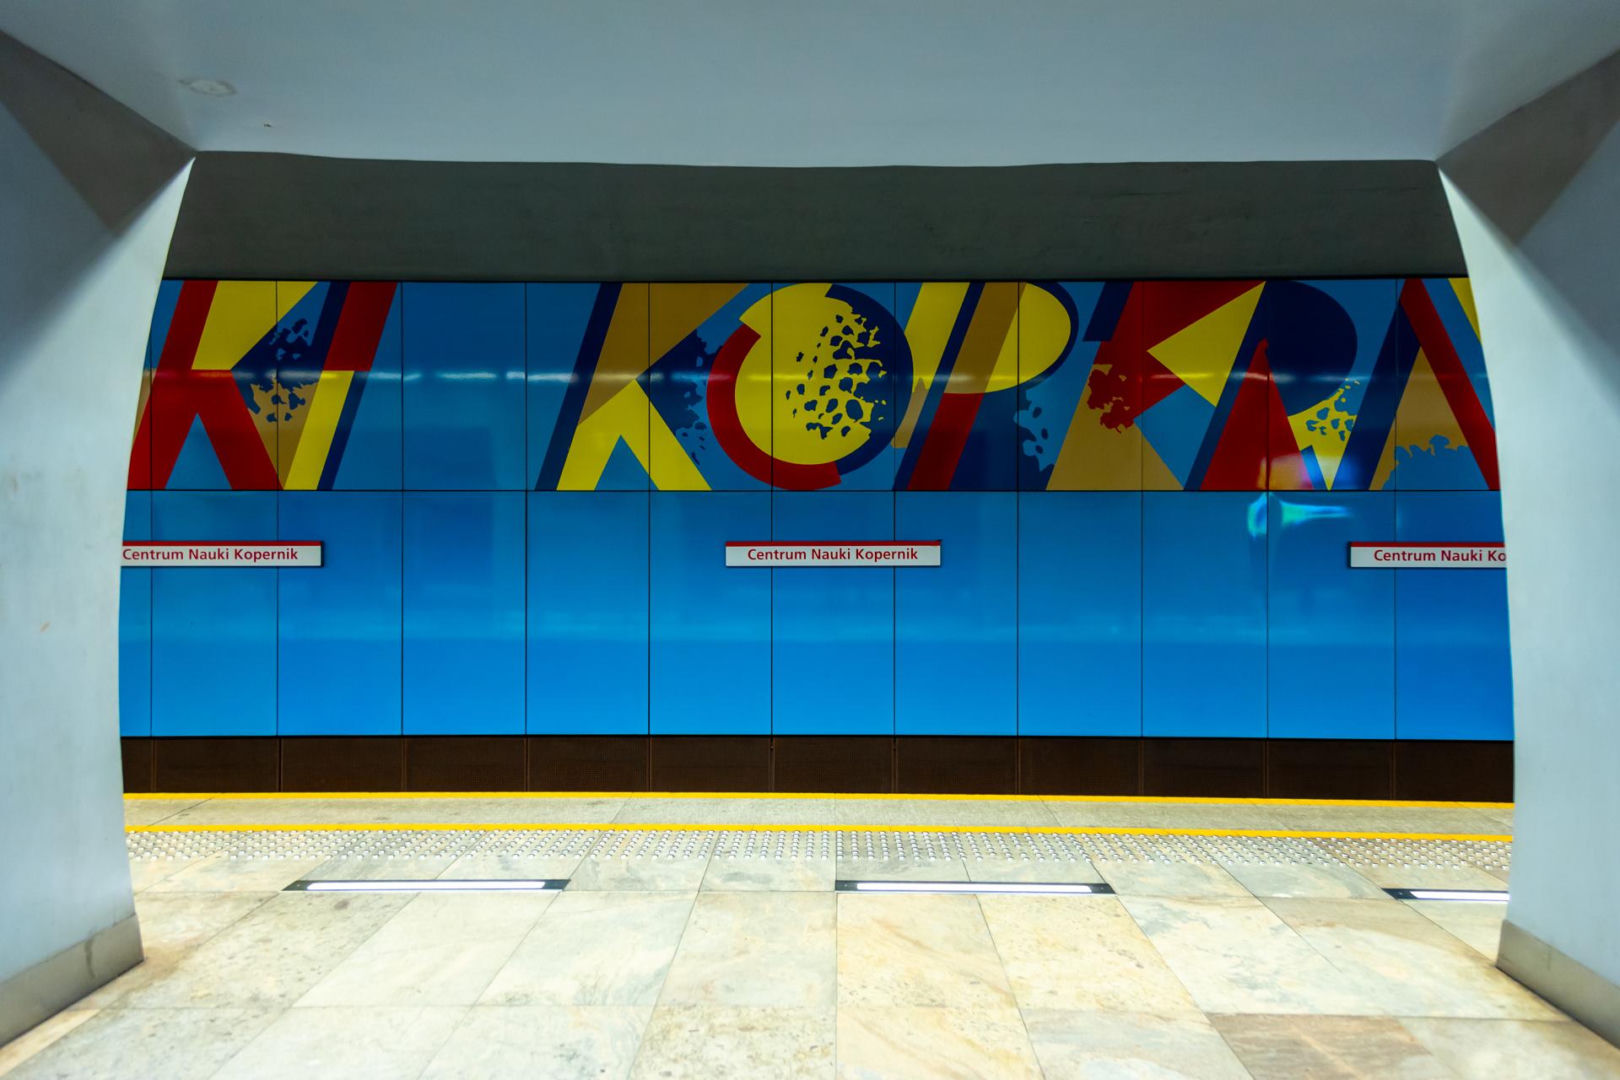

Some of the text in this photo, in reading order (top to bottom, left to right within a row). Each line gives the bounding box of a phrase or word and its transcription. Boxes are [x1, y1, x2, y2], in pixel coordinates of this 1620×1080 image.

[122, 548, 299, 563] Centrum Nauki Kopernik
[747, 548, 918, 563] Centrum Nauki Kopernik
[1374, 549, 1436, 562] Centrum
[1441, 549, 1483, 562] Nauki
